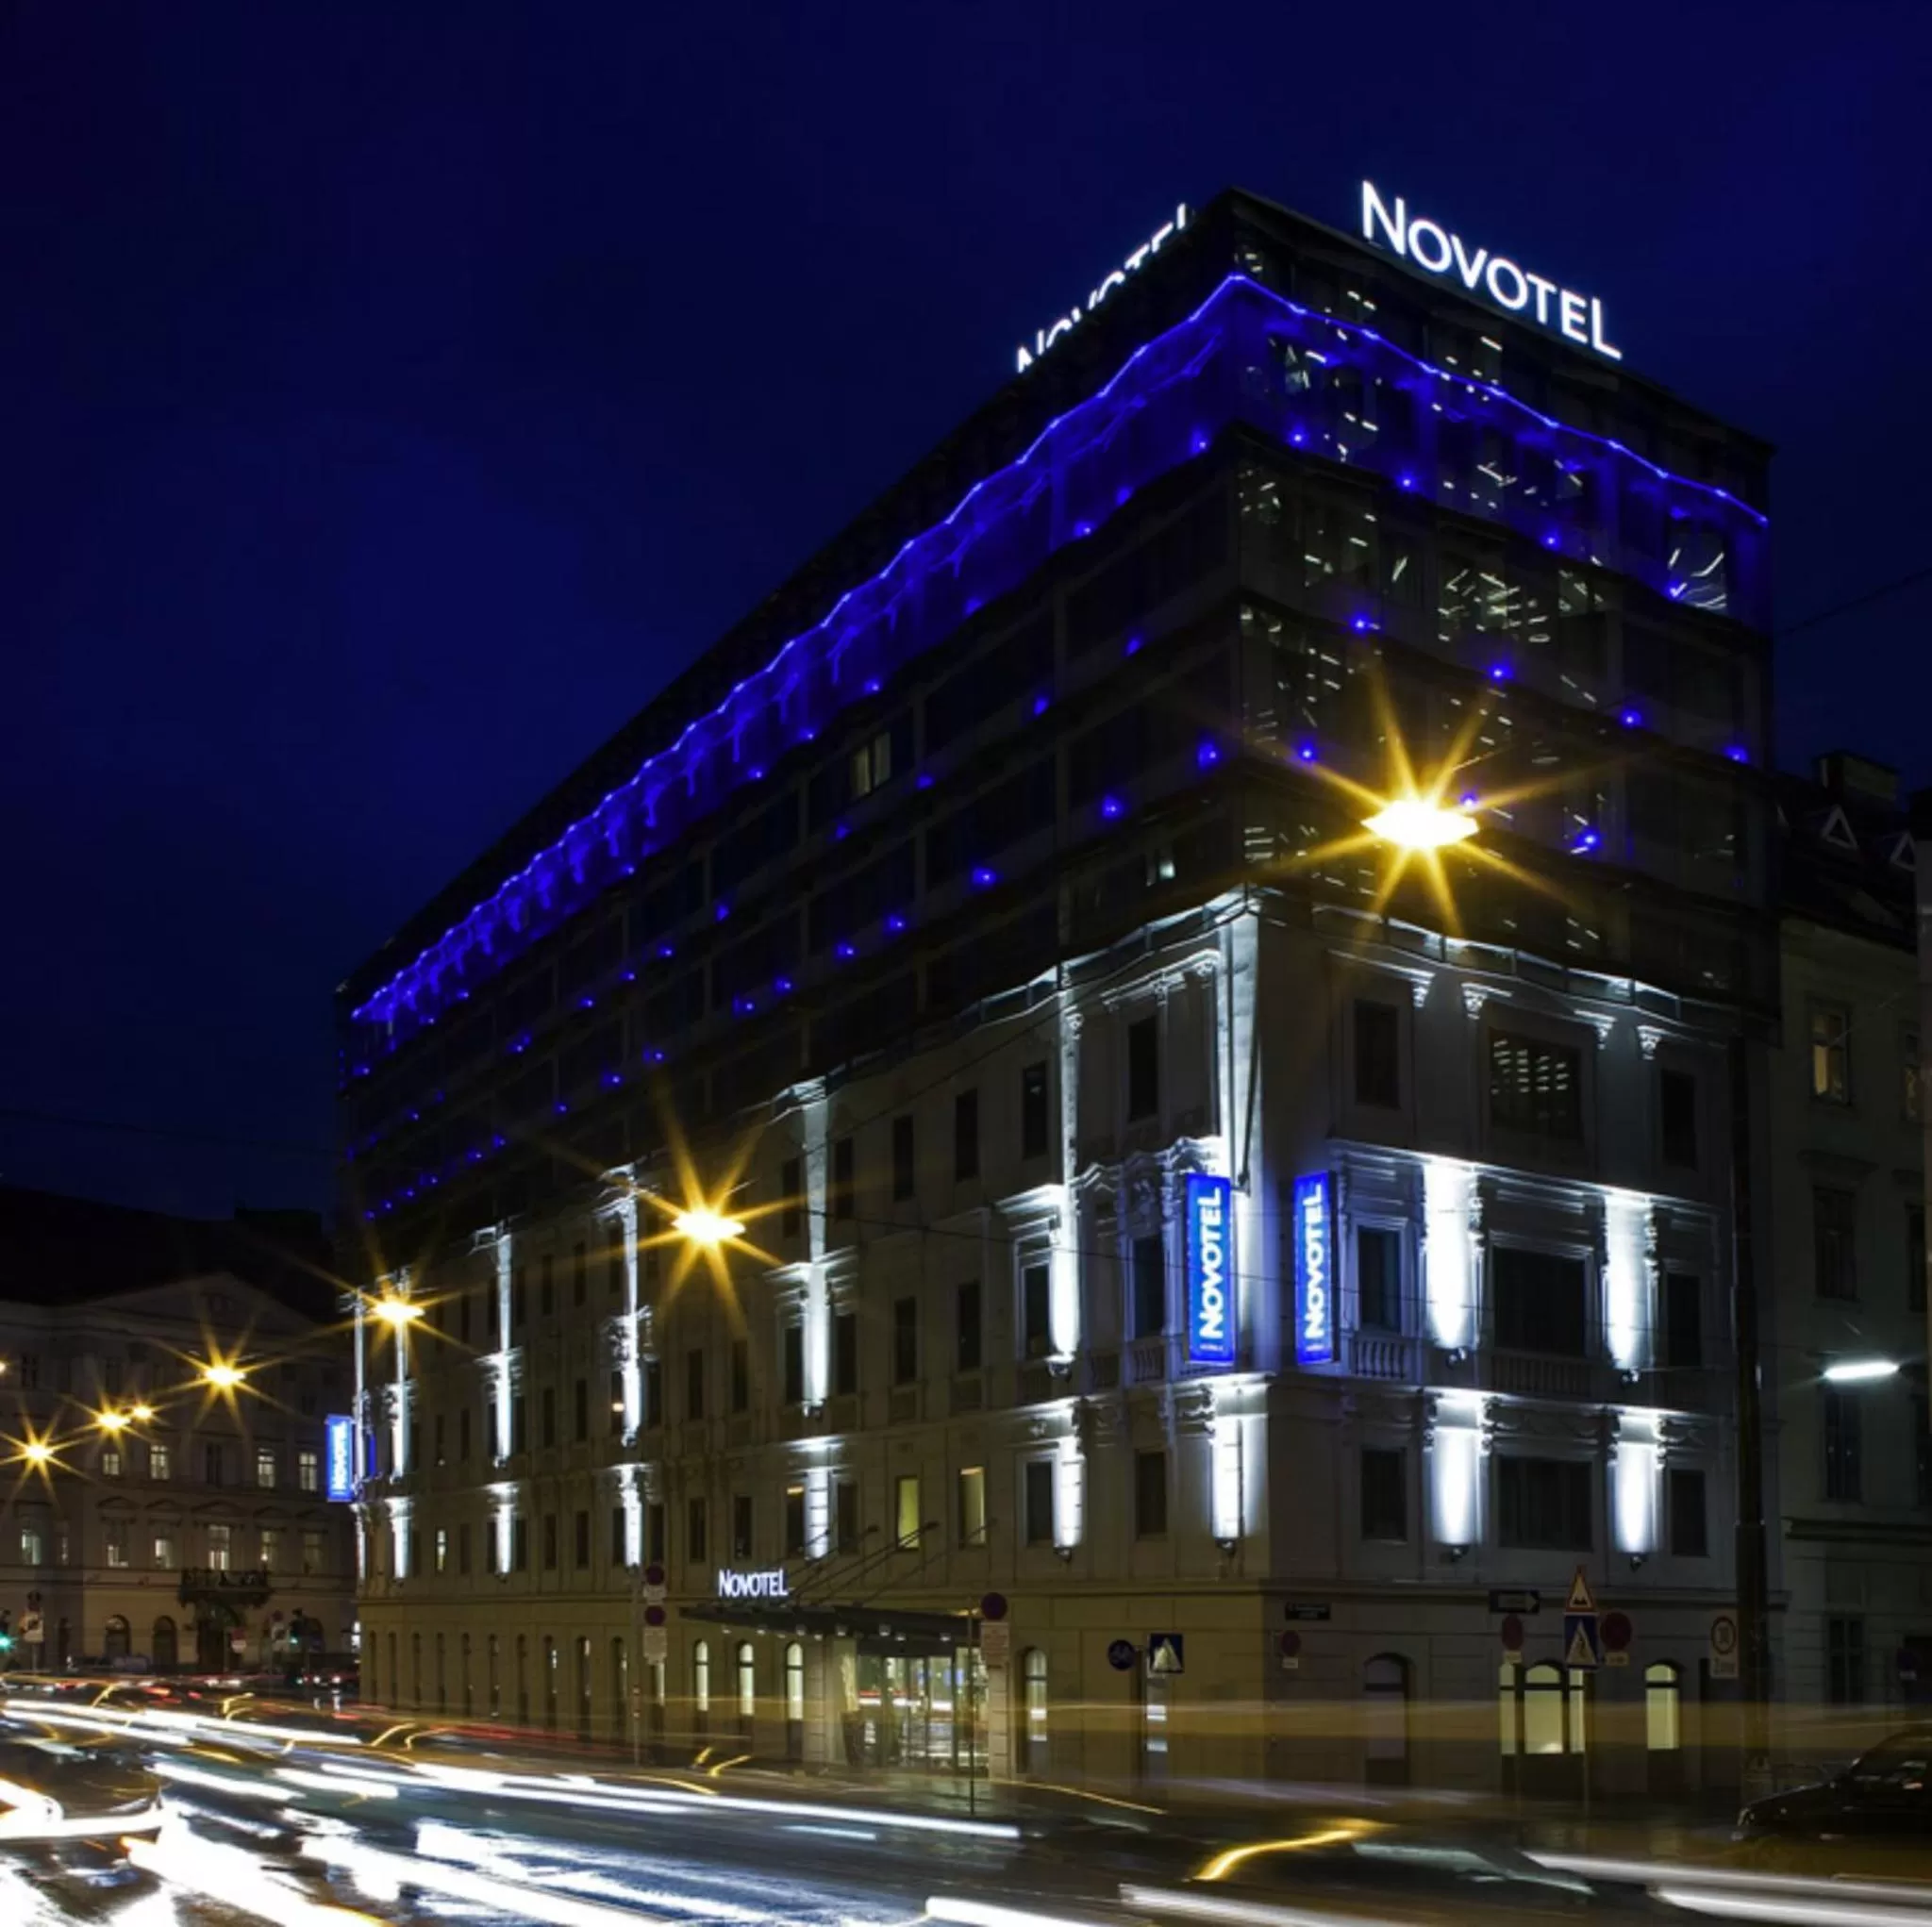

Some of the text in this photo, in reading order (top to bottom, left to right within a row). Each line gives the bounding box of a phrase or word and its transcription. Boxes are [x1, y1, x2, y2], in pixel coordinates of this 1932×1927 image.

[1361, 180, 1623, 360] NOVOTEL
[1197, 1187, 1224, 1339] NOVOTEL
[1303, 1184, 1325, 1339] NOVOTEL
[718, 1568, 789, 1598] NOVOTEL
